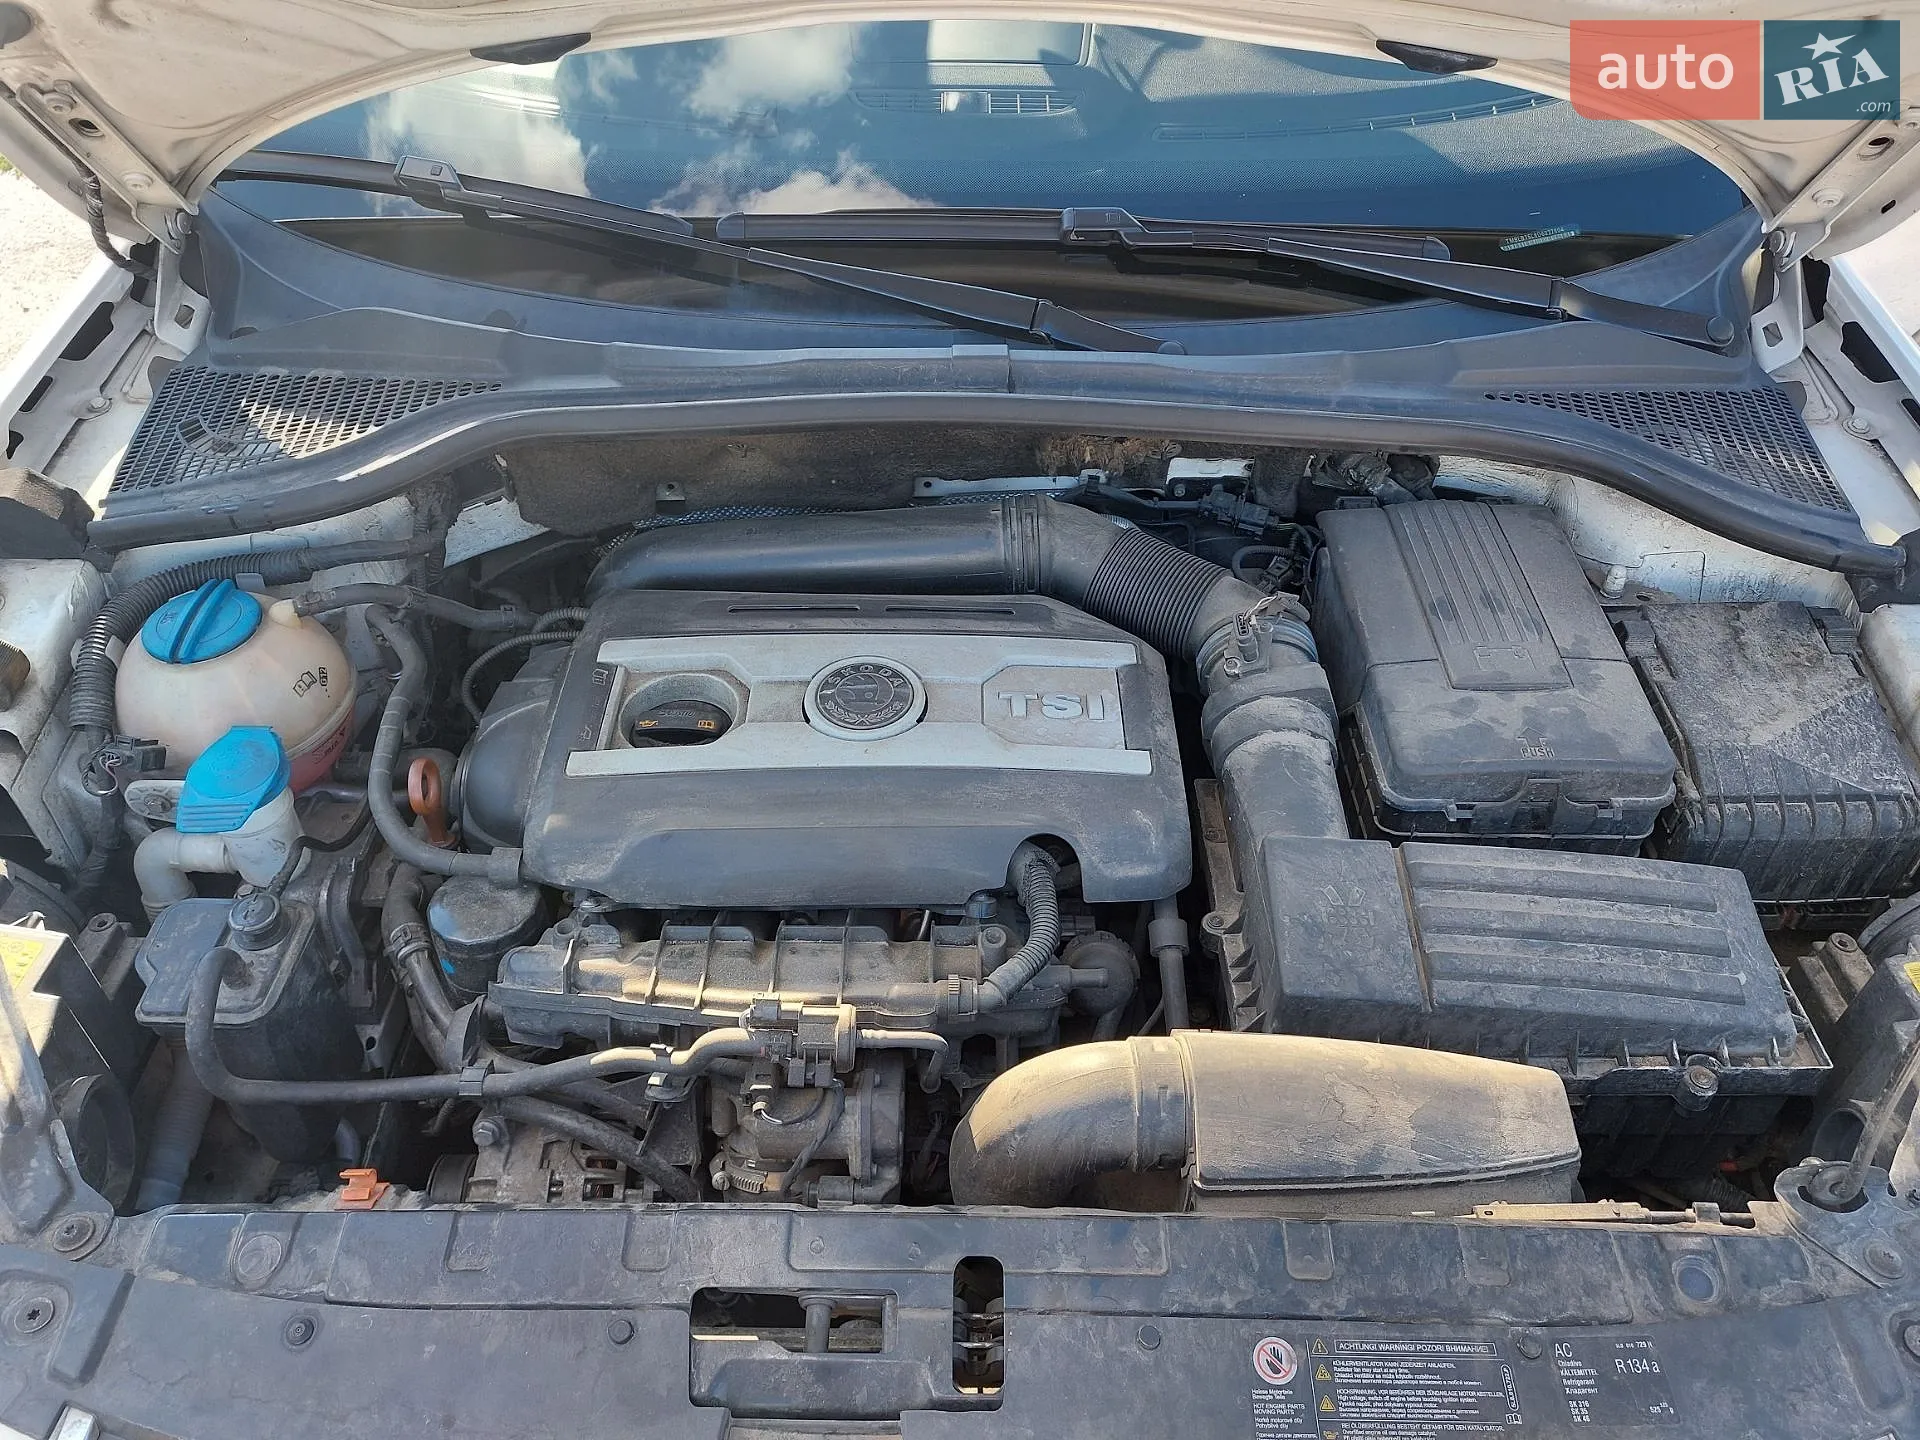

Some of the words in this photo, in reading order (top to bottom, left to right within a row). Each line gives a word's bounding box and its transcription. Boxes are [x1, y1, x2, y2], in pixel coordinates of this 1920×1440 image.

[998, 691, 1105, 721] TSI
[1520, 747, 1555, 758] PUSH
[1339, 1342, 1377, 1351] ACHTUNG!
[1378, 1343, 1415, 1351] WARNING!
[1416, 1344, 1444, 1352] POZOR!
[1554, 1342, 1573, 1358] AC
[1614, 1358, 1627, 1374] R
[1627, 1358, 1650, 1374] 134
[1652, 1361, 1660, 1373] a
[1560, 1368, 1599, 1376] KÄLTEMITTEL
[1562, 1378, 1595, 1386] Refrigerant
